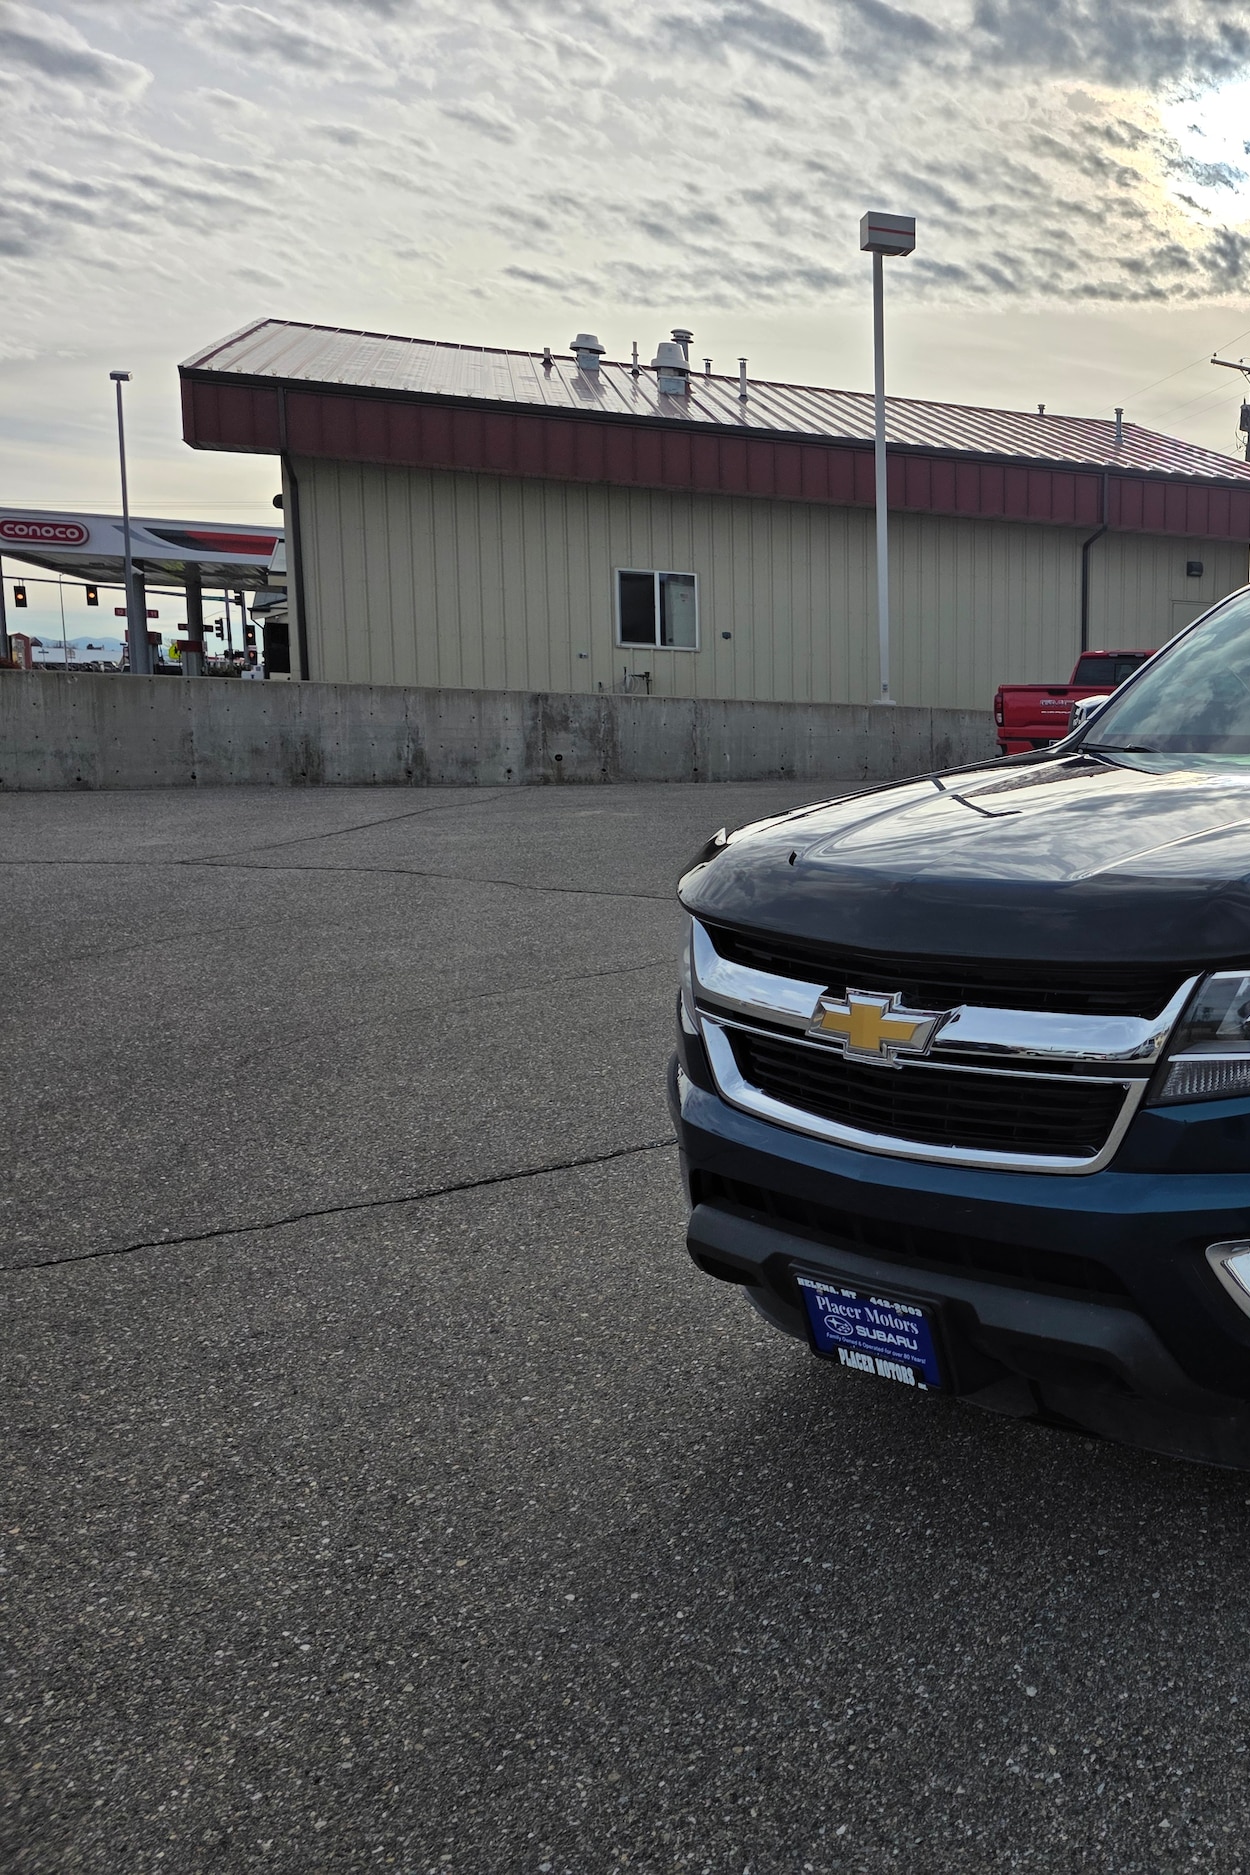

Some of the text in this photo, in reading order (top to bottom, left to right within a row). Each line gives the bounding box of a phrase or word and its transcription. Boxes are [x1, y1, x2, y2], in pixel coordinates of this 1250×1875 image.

[815, 1295, 919, 1334] Placer Motors
[827, 1332, 841, 1342] Family
[842, 1336, 857, 1345] Owned
[862, 1342, 884, 1353] Operated
[884, 1347, 892, 1355] for
[855, 1326, 917, 1350] SUBARU
[838, 1347, 875, 1374] PLACER
[875, 1357, 915, 1386] MOTORS
